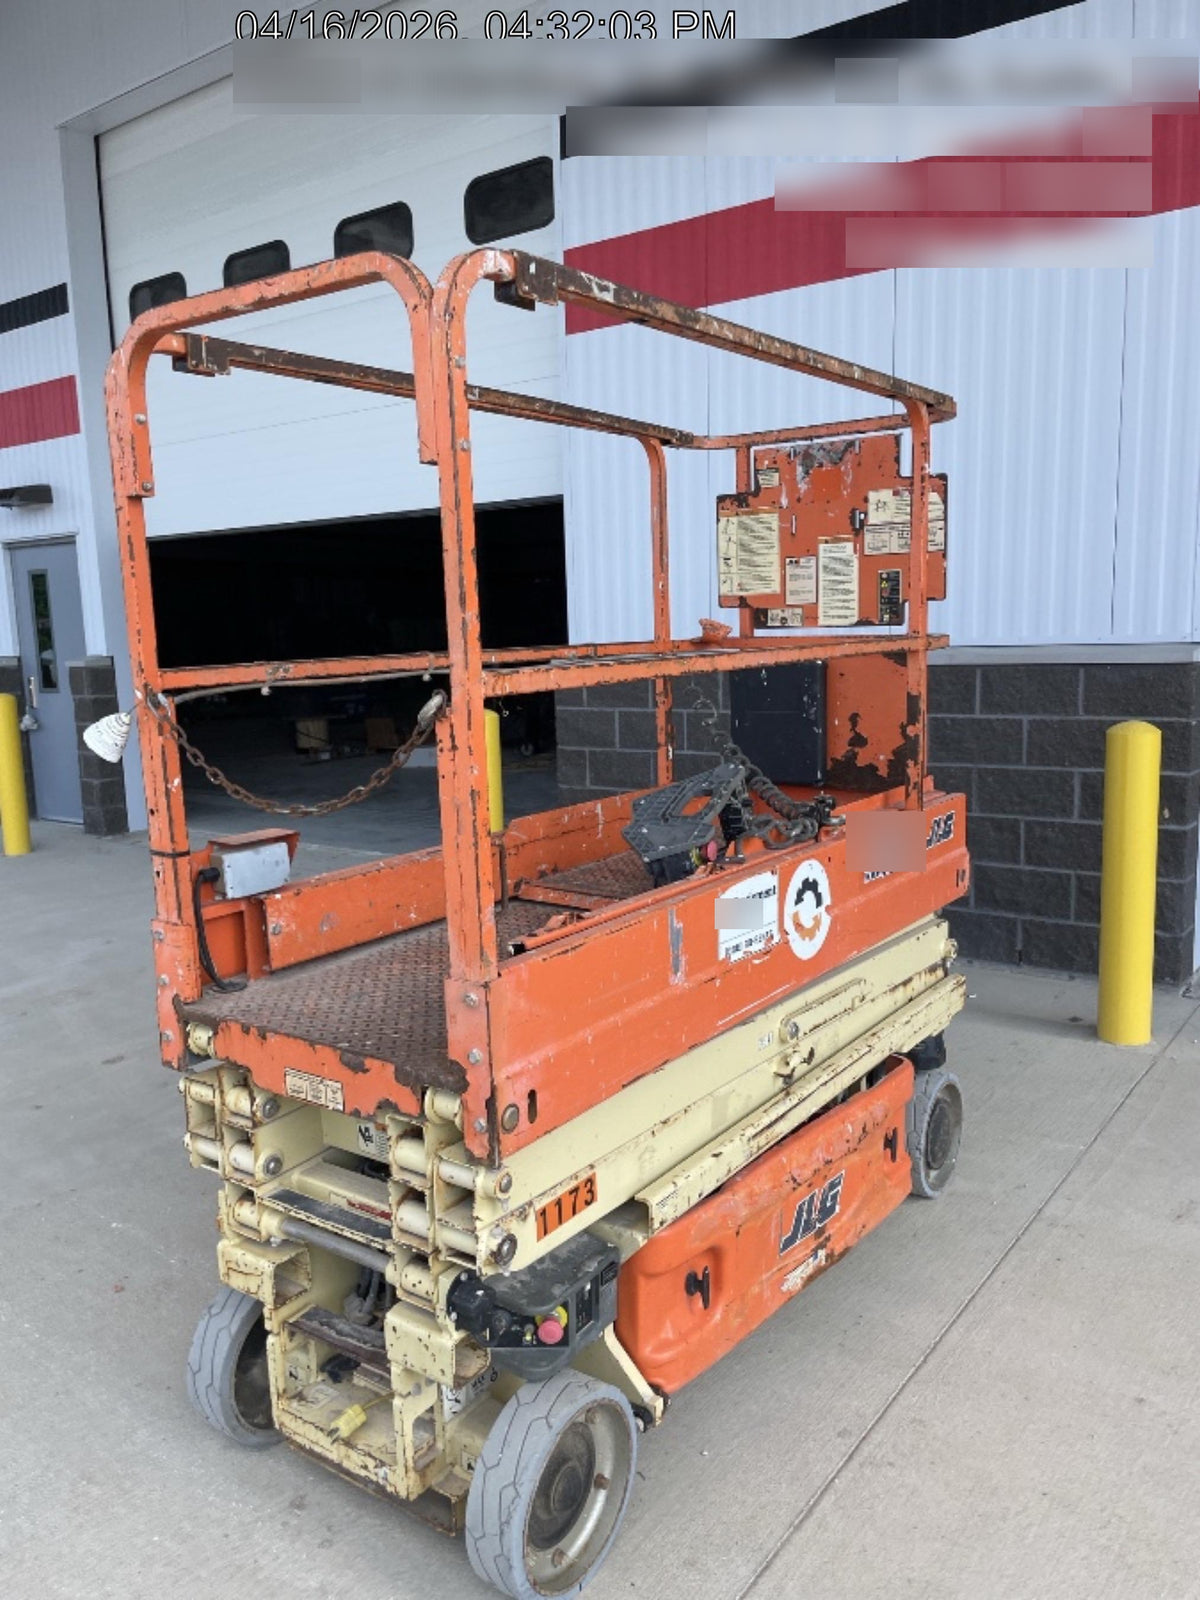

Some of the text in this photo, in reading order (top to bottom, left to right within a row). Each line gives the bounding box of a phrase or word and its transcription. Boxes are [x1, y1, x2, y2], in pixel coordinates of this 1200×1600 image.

[926, 810, 956, 850] JLG
[539, 1176, 595, 1237] 1173
[779, 1168, 846, 1257] JLG
